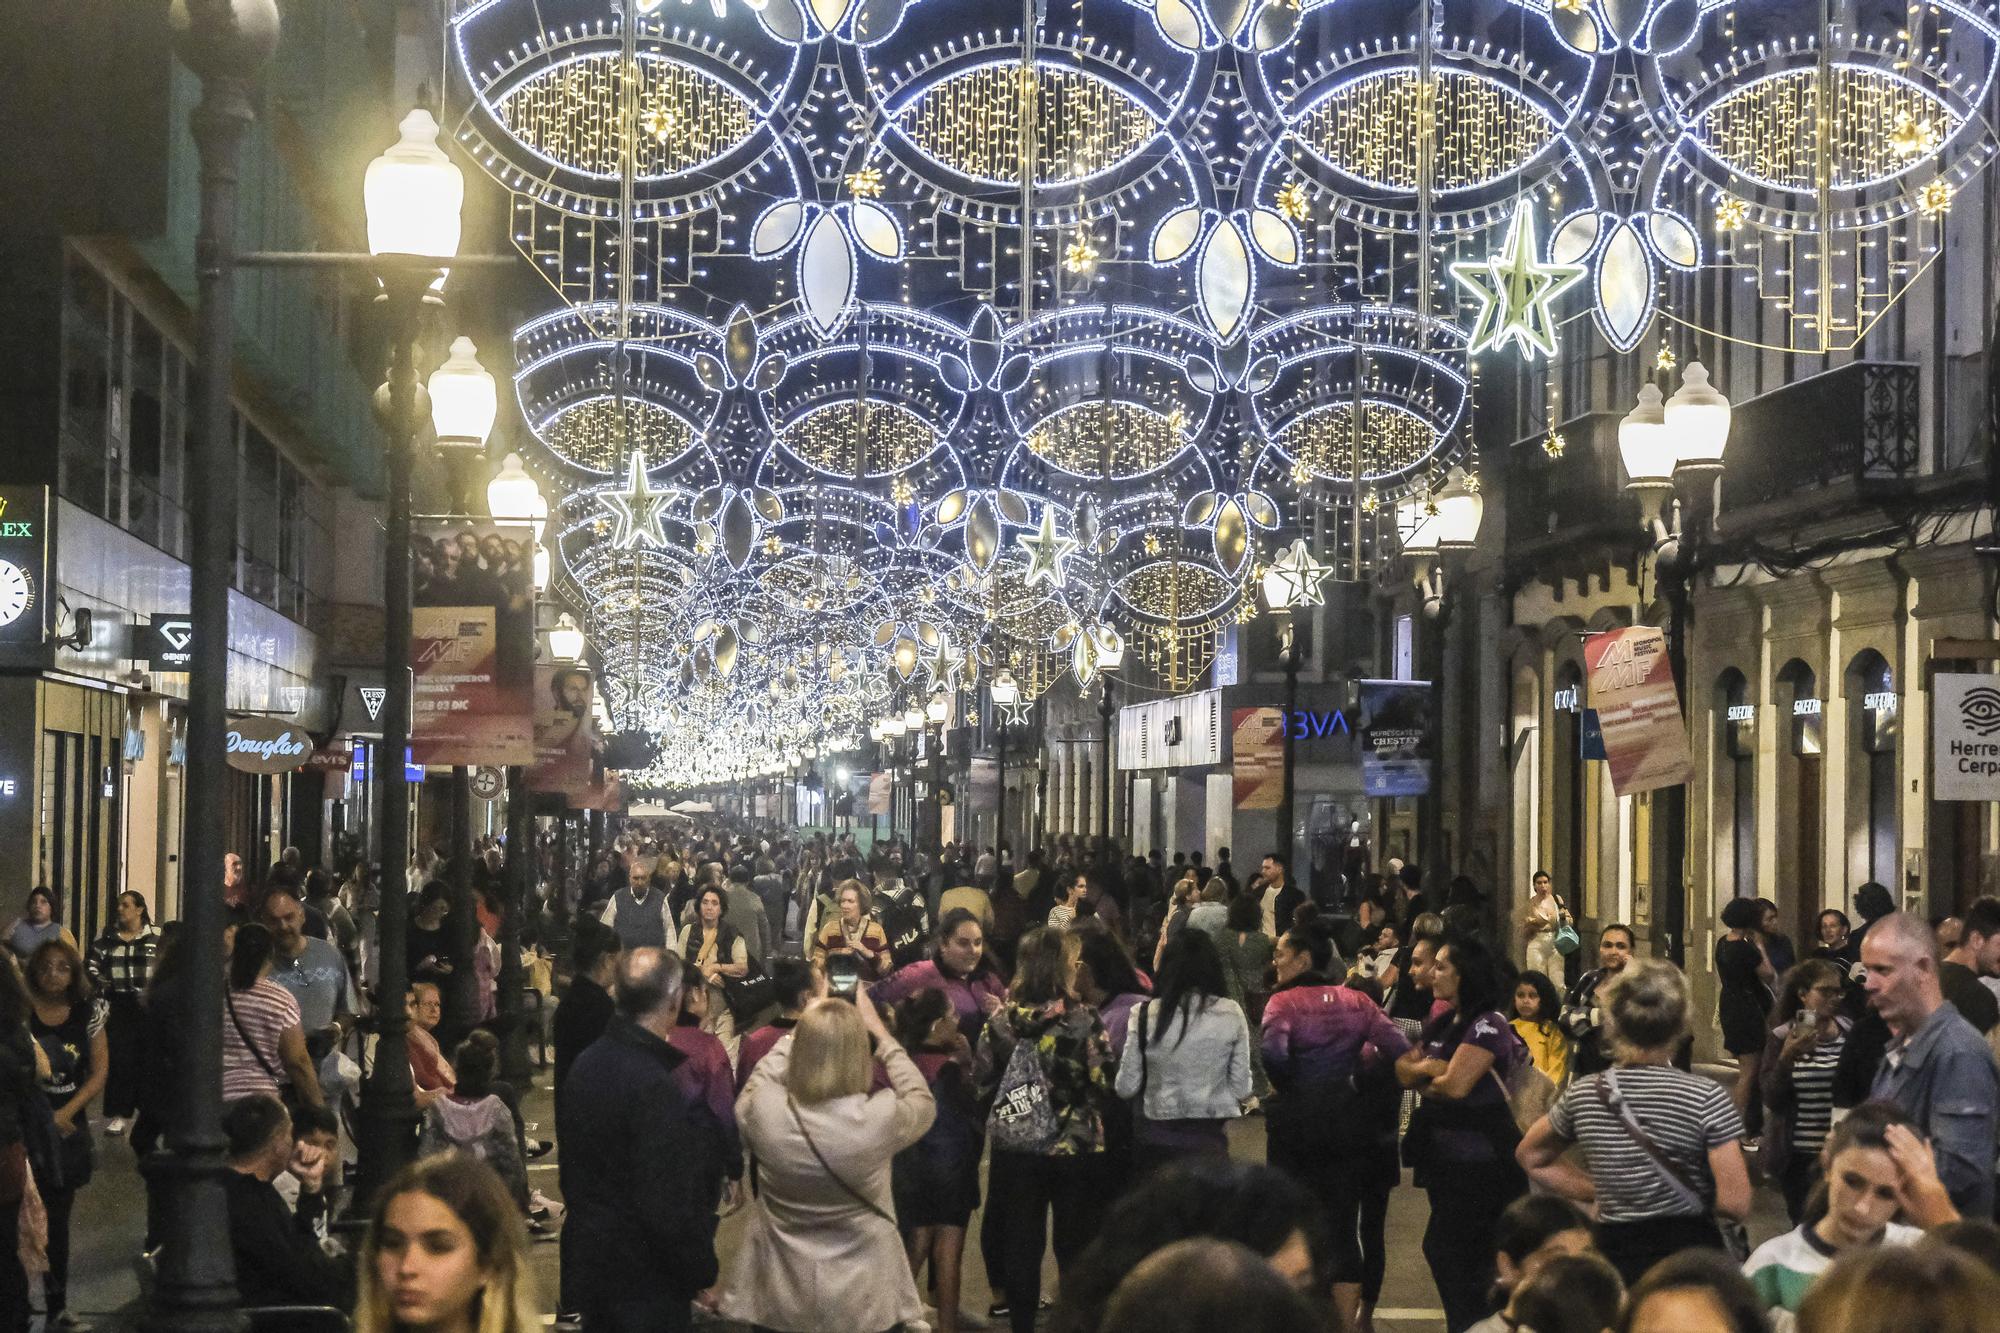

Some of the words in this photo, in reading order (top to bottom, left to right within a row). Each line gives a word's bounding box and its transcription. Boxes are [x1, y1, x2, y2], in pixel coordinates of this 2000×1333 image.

[1633, 644, 1652, 652] MUSIC
[1634, 648, 1659, 657] FESTIVAL
[226, 731, 304, 760] Douglas
[1950, 740, 2000, 756] Herre
[1958, 757, 2000, 777] Cerp
